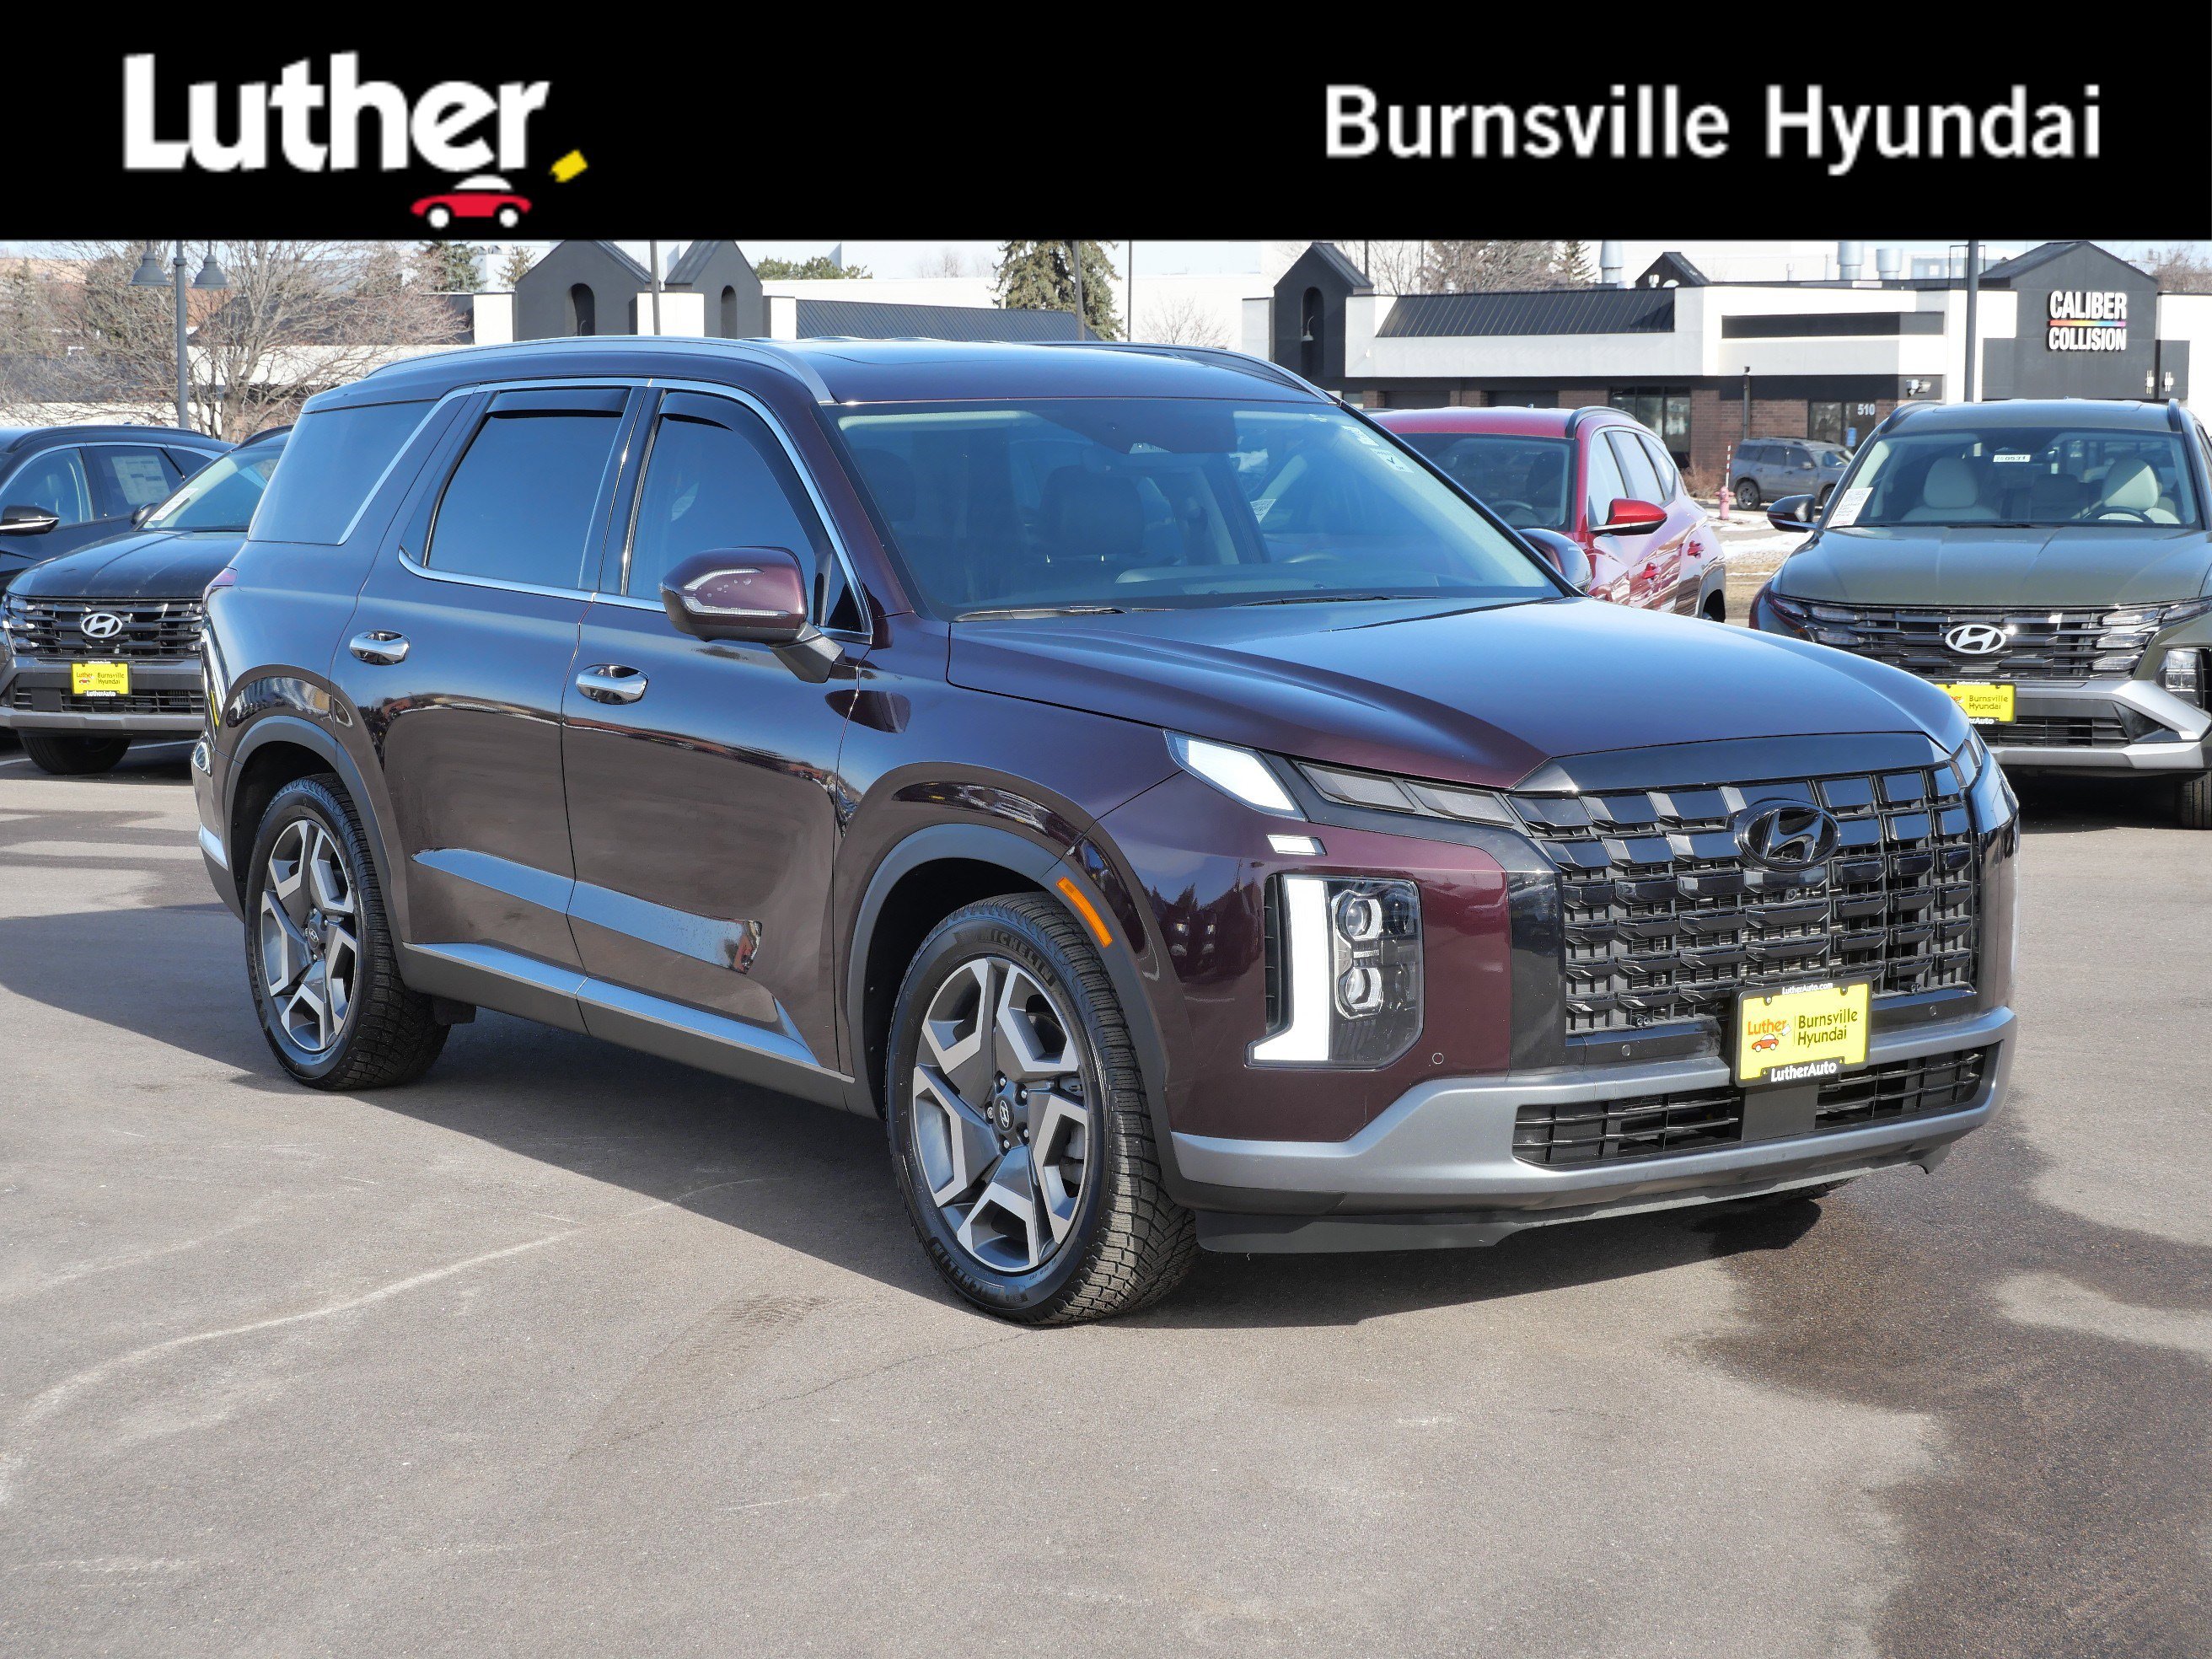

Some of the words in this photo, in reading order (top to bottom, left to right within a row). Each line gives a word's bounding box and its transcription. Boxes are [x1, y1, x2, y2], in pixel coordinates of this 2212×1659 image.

[2049, 291, 2127, 319] CALIBER
[2048, 327, 2127, 350] COLLISION
[1857, 403, 1876, 416] 510
[978, 928, 1056, 984] MICHELIN
[1781, 982, 1833, 996] LutherAuto.com
[1748, 1018, 1787, 1035] Luther
[1798, 1007, 1858, 1029] Burnsville
[1797, 1025, 1847, 1048] Hyundai
[1770, 1061, 1837, 1082] LutherAuto
